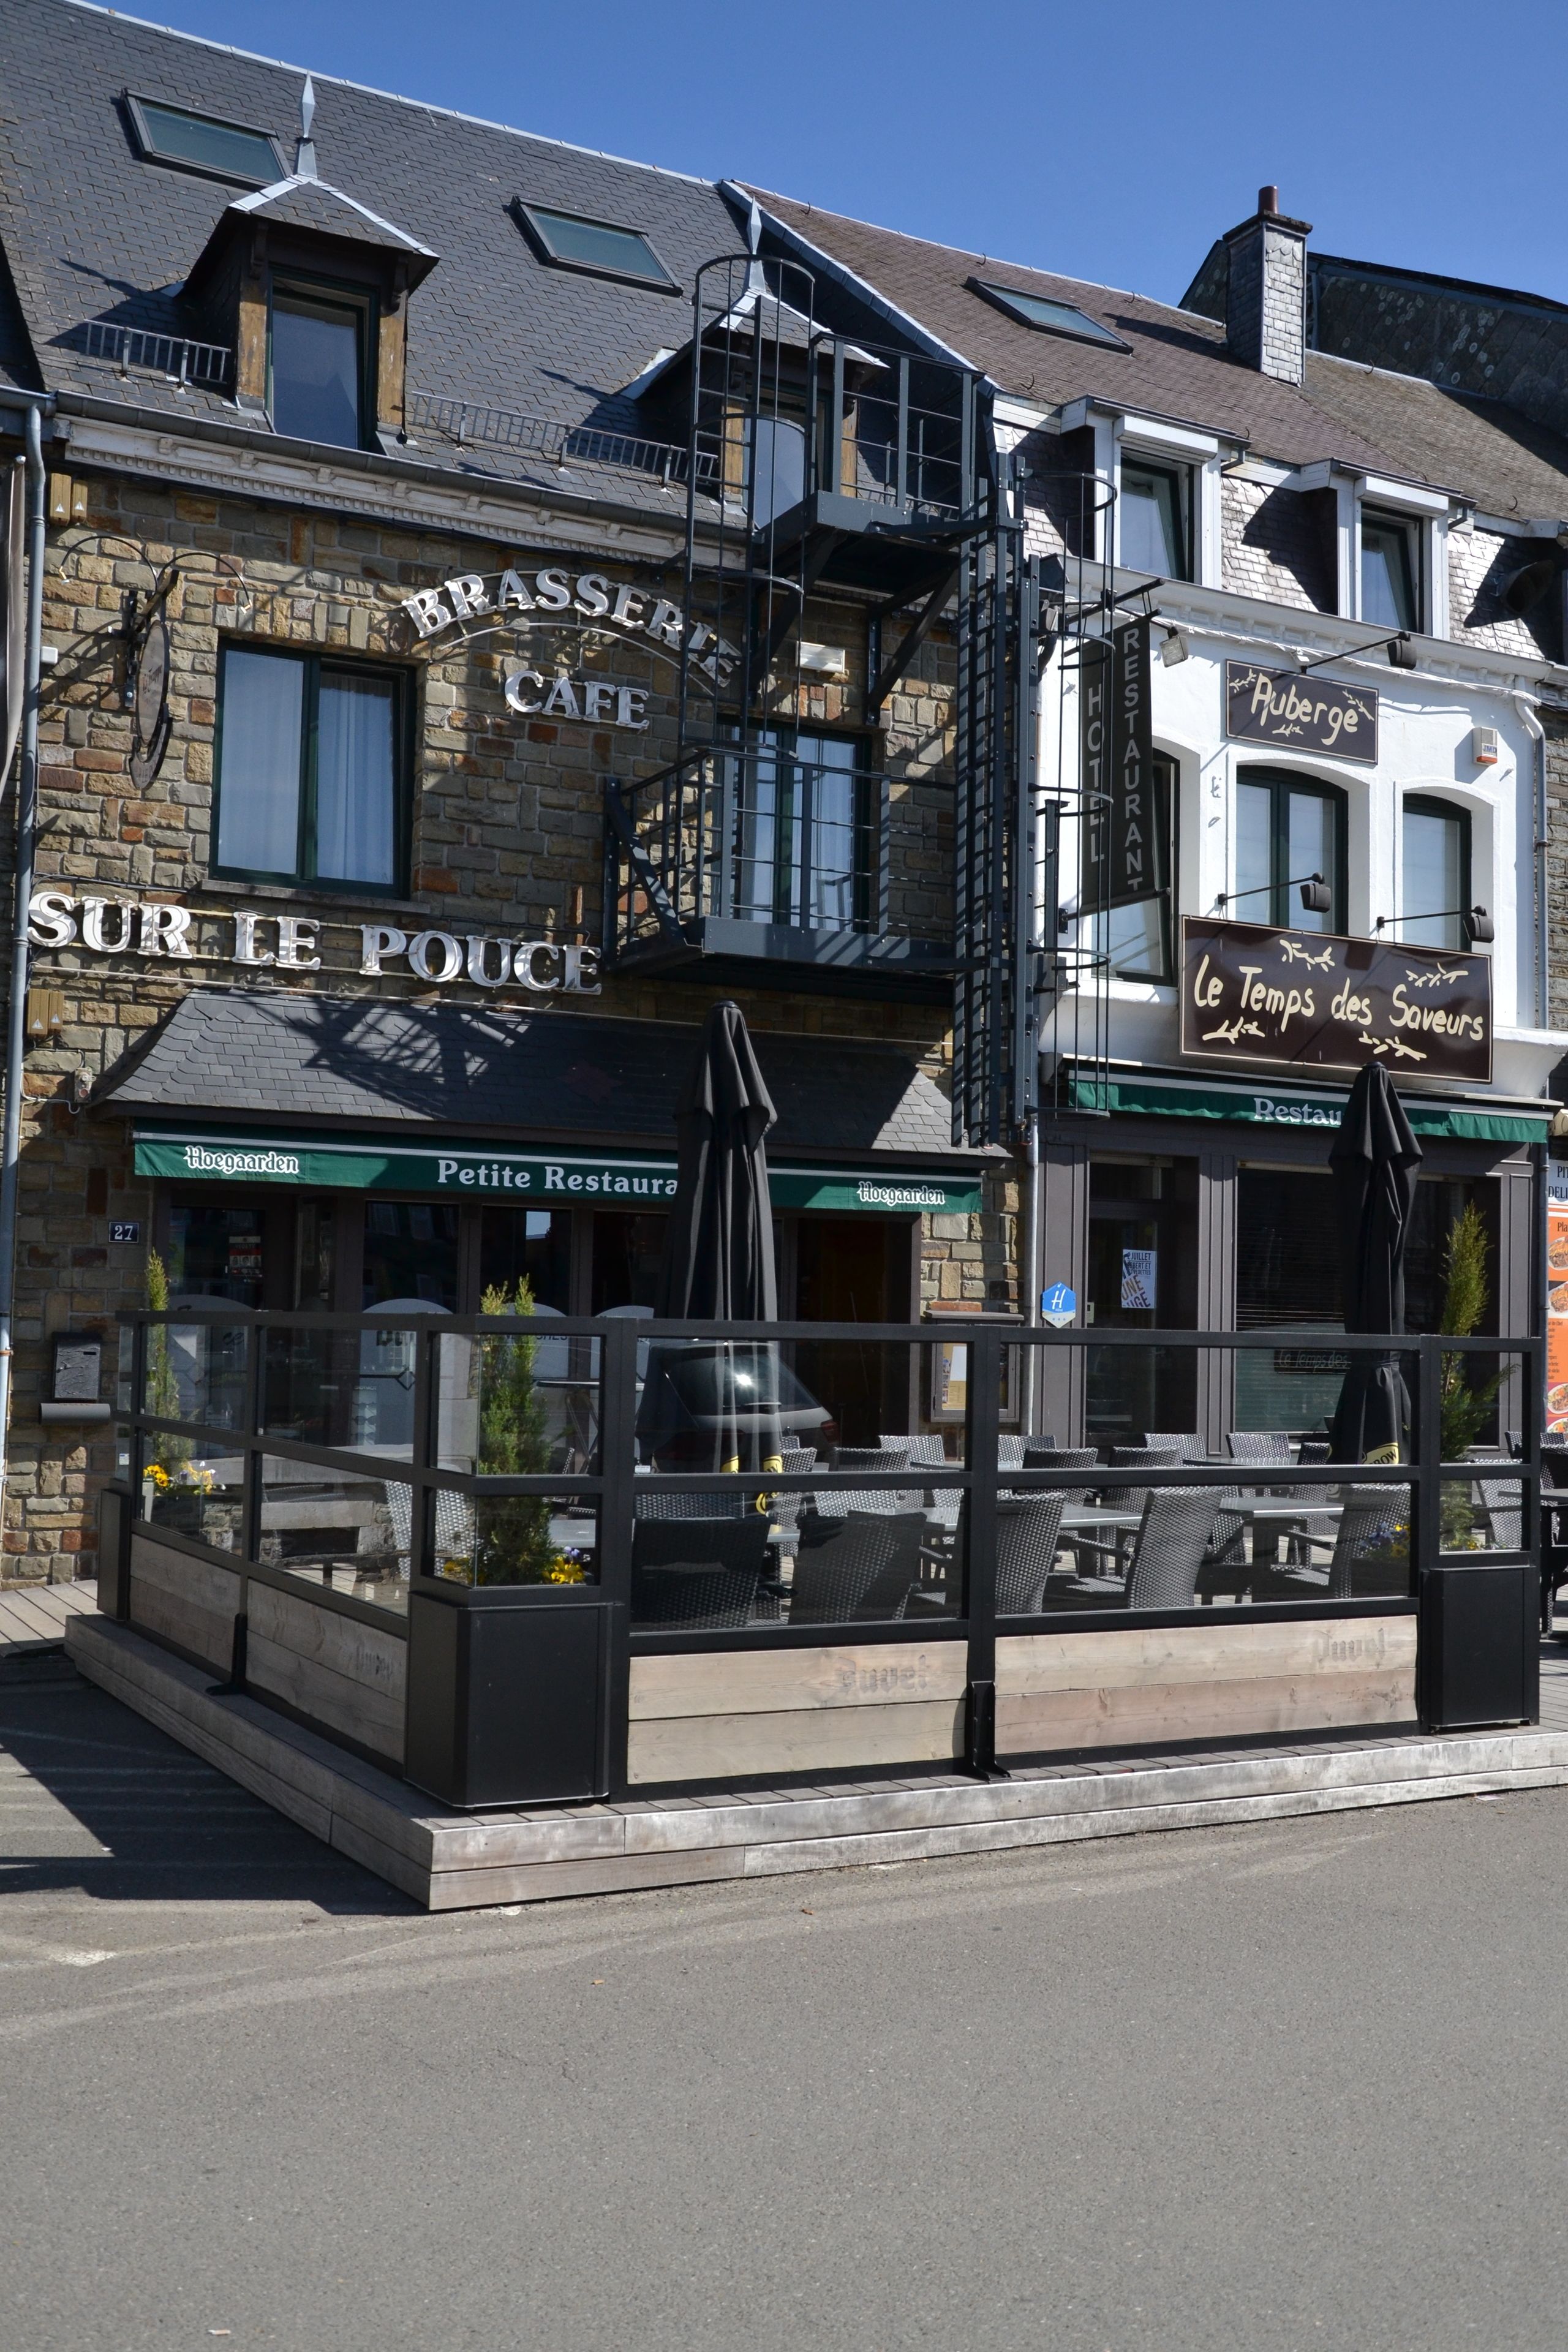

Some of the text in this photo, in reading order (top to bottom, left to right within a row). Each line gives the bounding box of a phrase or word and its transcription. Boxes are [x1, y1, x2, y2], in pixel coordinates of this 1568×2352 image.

[401, 568, 742, 688] BRASSERIE
[505, 670, 650, 729] CAFE
[1251, 673, 1359, 745] Auberge
[1087, 684, 1105, 862] HOTEL
[1123, 628, 1144, 891] RESTAURANT
[28, 891, 602, 995] SUR LE POUCE
[1238, 965, 1315, 1032] Temps
[1331, 977, 1373, 1026] des
[1389, 984, 1484, 1041] Saveurs
[1253, 1098, 1342, 1126] Restau
[183, 1145, 300, 1174] Hoegaarden
[437, 1159, 678, 1195] Petite Restaura
[1557, 1166, 1568, 1178] PI
[857, 1181, 946, 1206] Hoegaarden
[1548, 1186, 1568, 1199] DELI
[115, 1225, 133, 1240] 27
[1557, 1221, 1568, 1233] Pla
